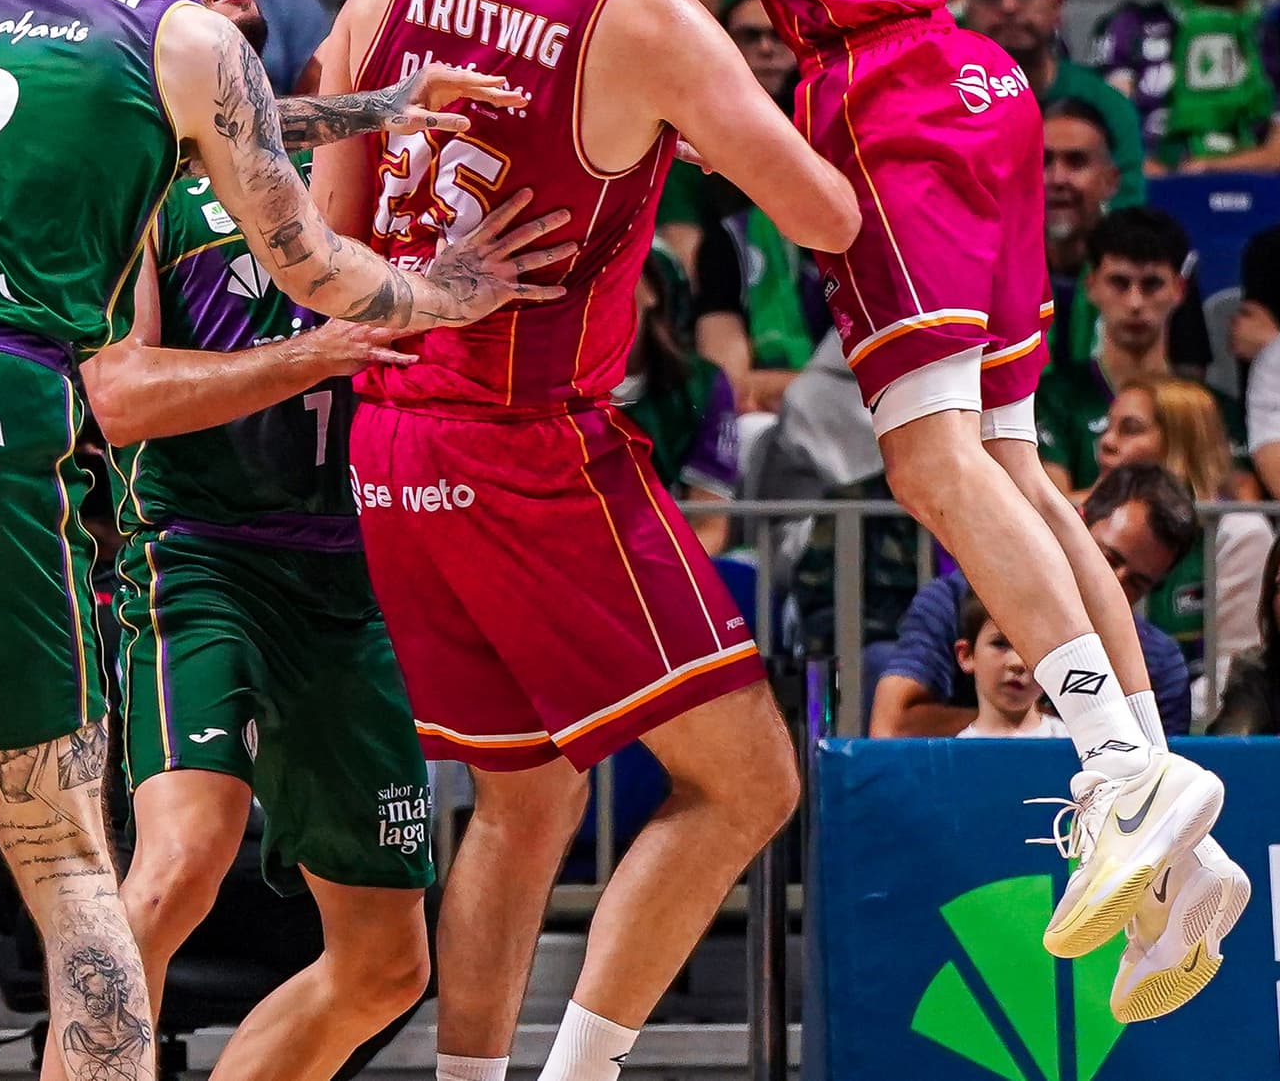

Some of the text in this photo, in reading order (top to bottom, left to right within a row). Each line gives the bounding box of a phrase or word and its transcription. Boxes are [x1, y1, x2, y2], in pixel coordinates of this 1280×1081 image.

[373, 125, 512, 245] 25
[377, 782, 414, 800] sabor
[379, 819, 426, 855] laga
